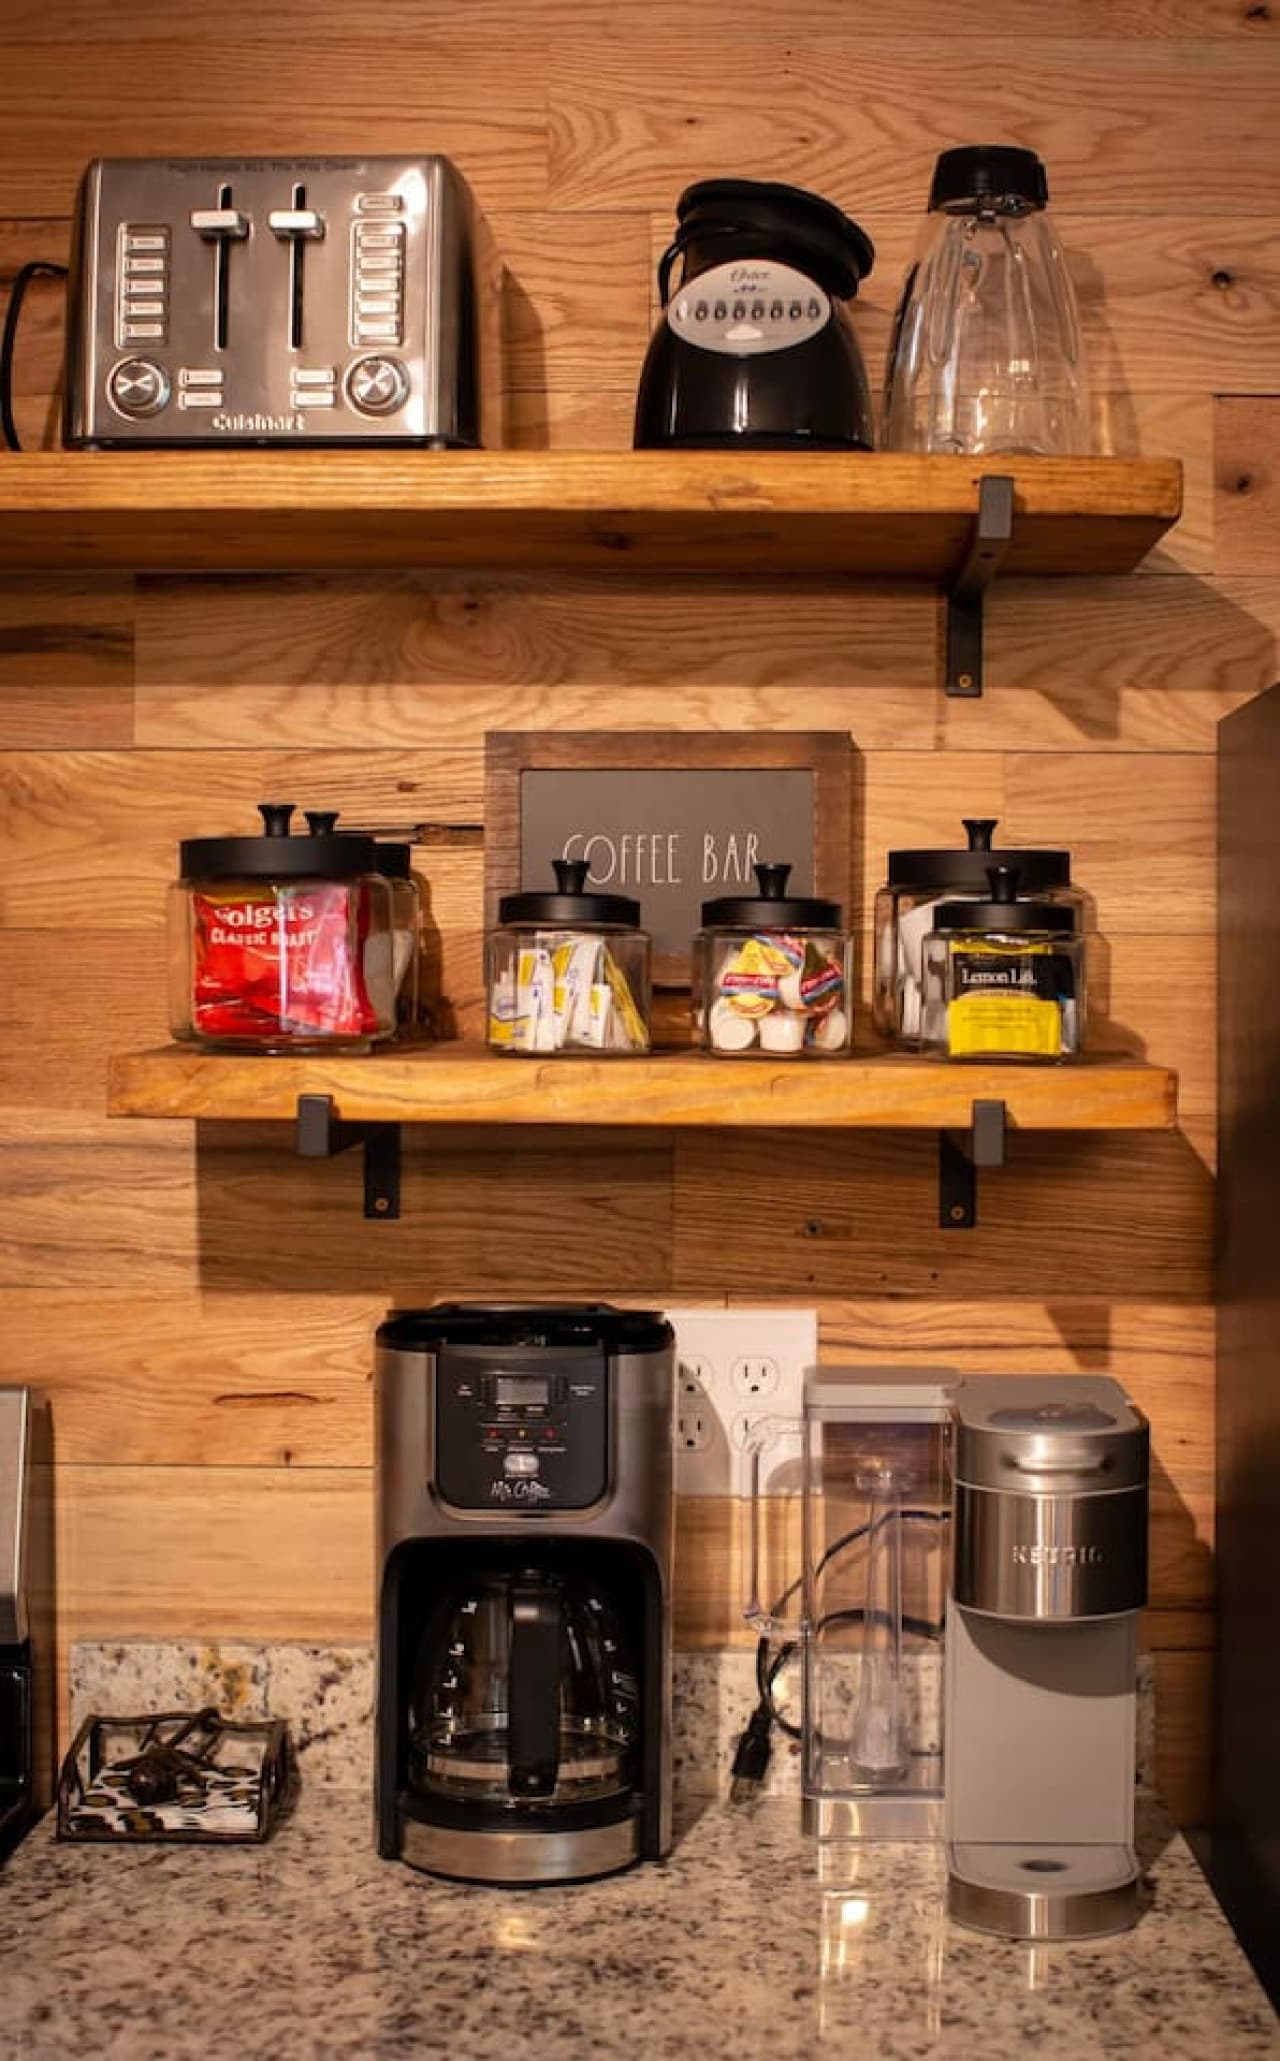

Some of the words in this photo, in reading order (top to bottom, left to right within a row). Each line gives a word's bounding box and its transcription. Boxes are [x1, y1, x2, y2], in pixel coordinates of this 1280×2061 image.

[563, 834, 681, 885] COFFEE
[703, 833, 761, 884] BAR
[962, 968, 1009, 985] Lemon
